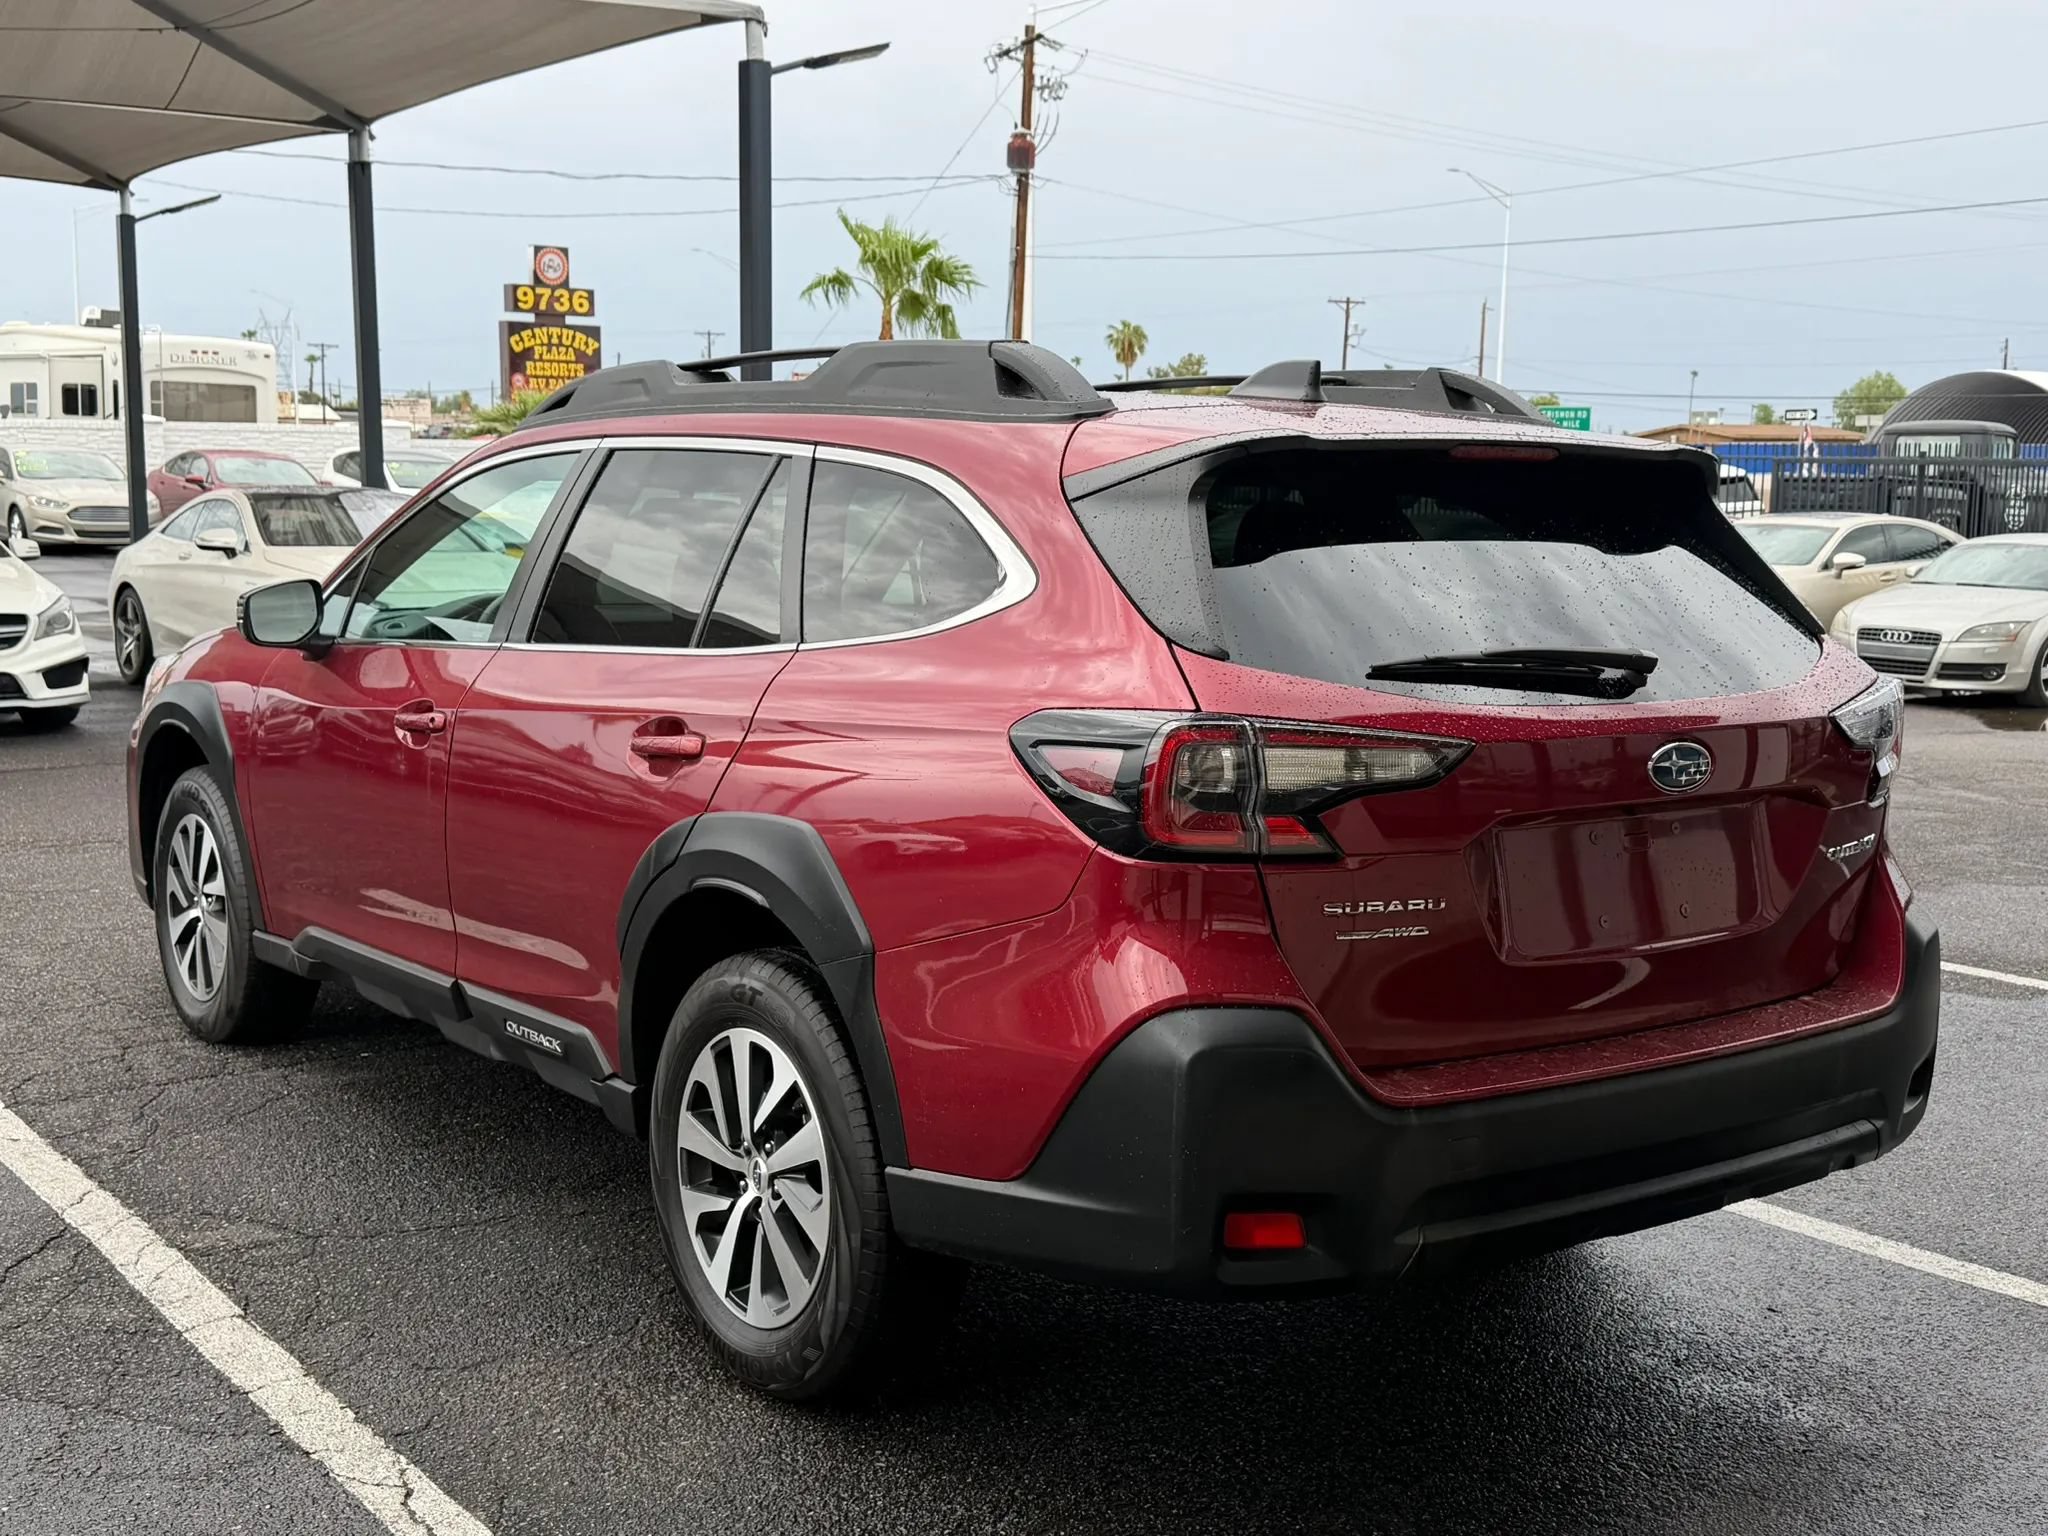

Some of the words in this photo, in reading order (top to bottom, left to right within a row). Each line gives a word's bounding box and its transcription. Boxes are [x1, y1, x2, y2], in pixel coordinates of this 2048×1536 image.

[516, 285, 590, 314] 9736
[509, 326, 600, 357] CENTURY
[170, 353, 238, 366] DESIGNER
[533, 345, 576, 361] PLAZA
[525, 360, 585, 377] RESORTS
[528, 377, 547, 390] RV
[1562, 419, 1581, 429] MILE
[1323, 898, 1446, 915] SUBARU
[1372, 926, 1430, 939] AWD
[730, 983, 764, 1006] GT
[506, 1021, 562, 1053] OUTBACK
